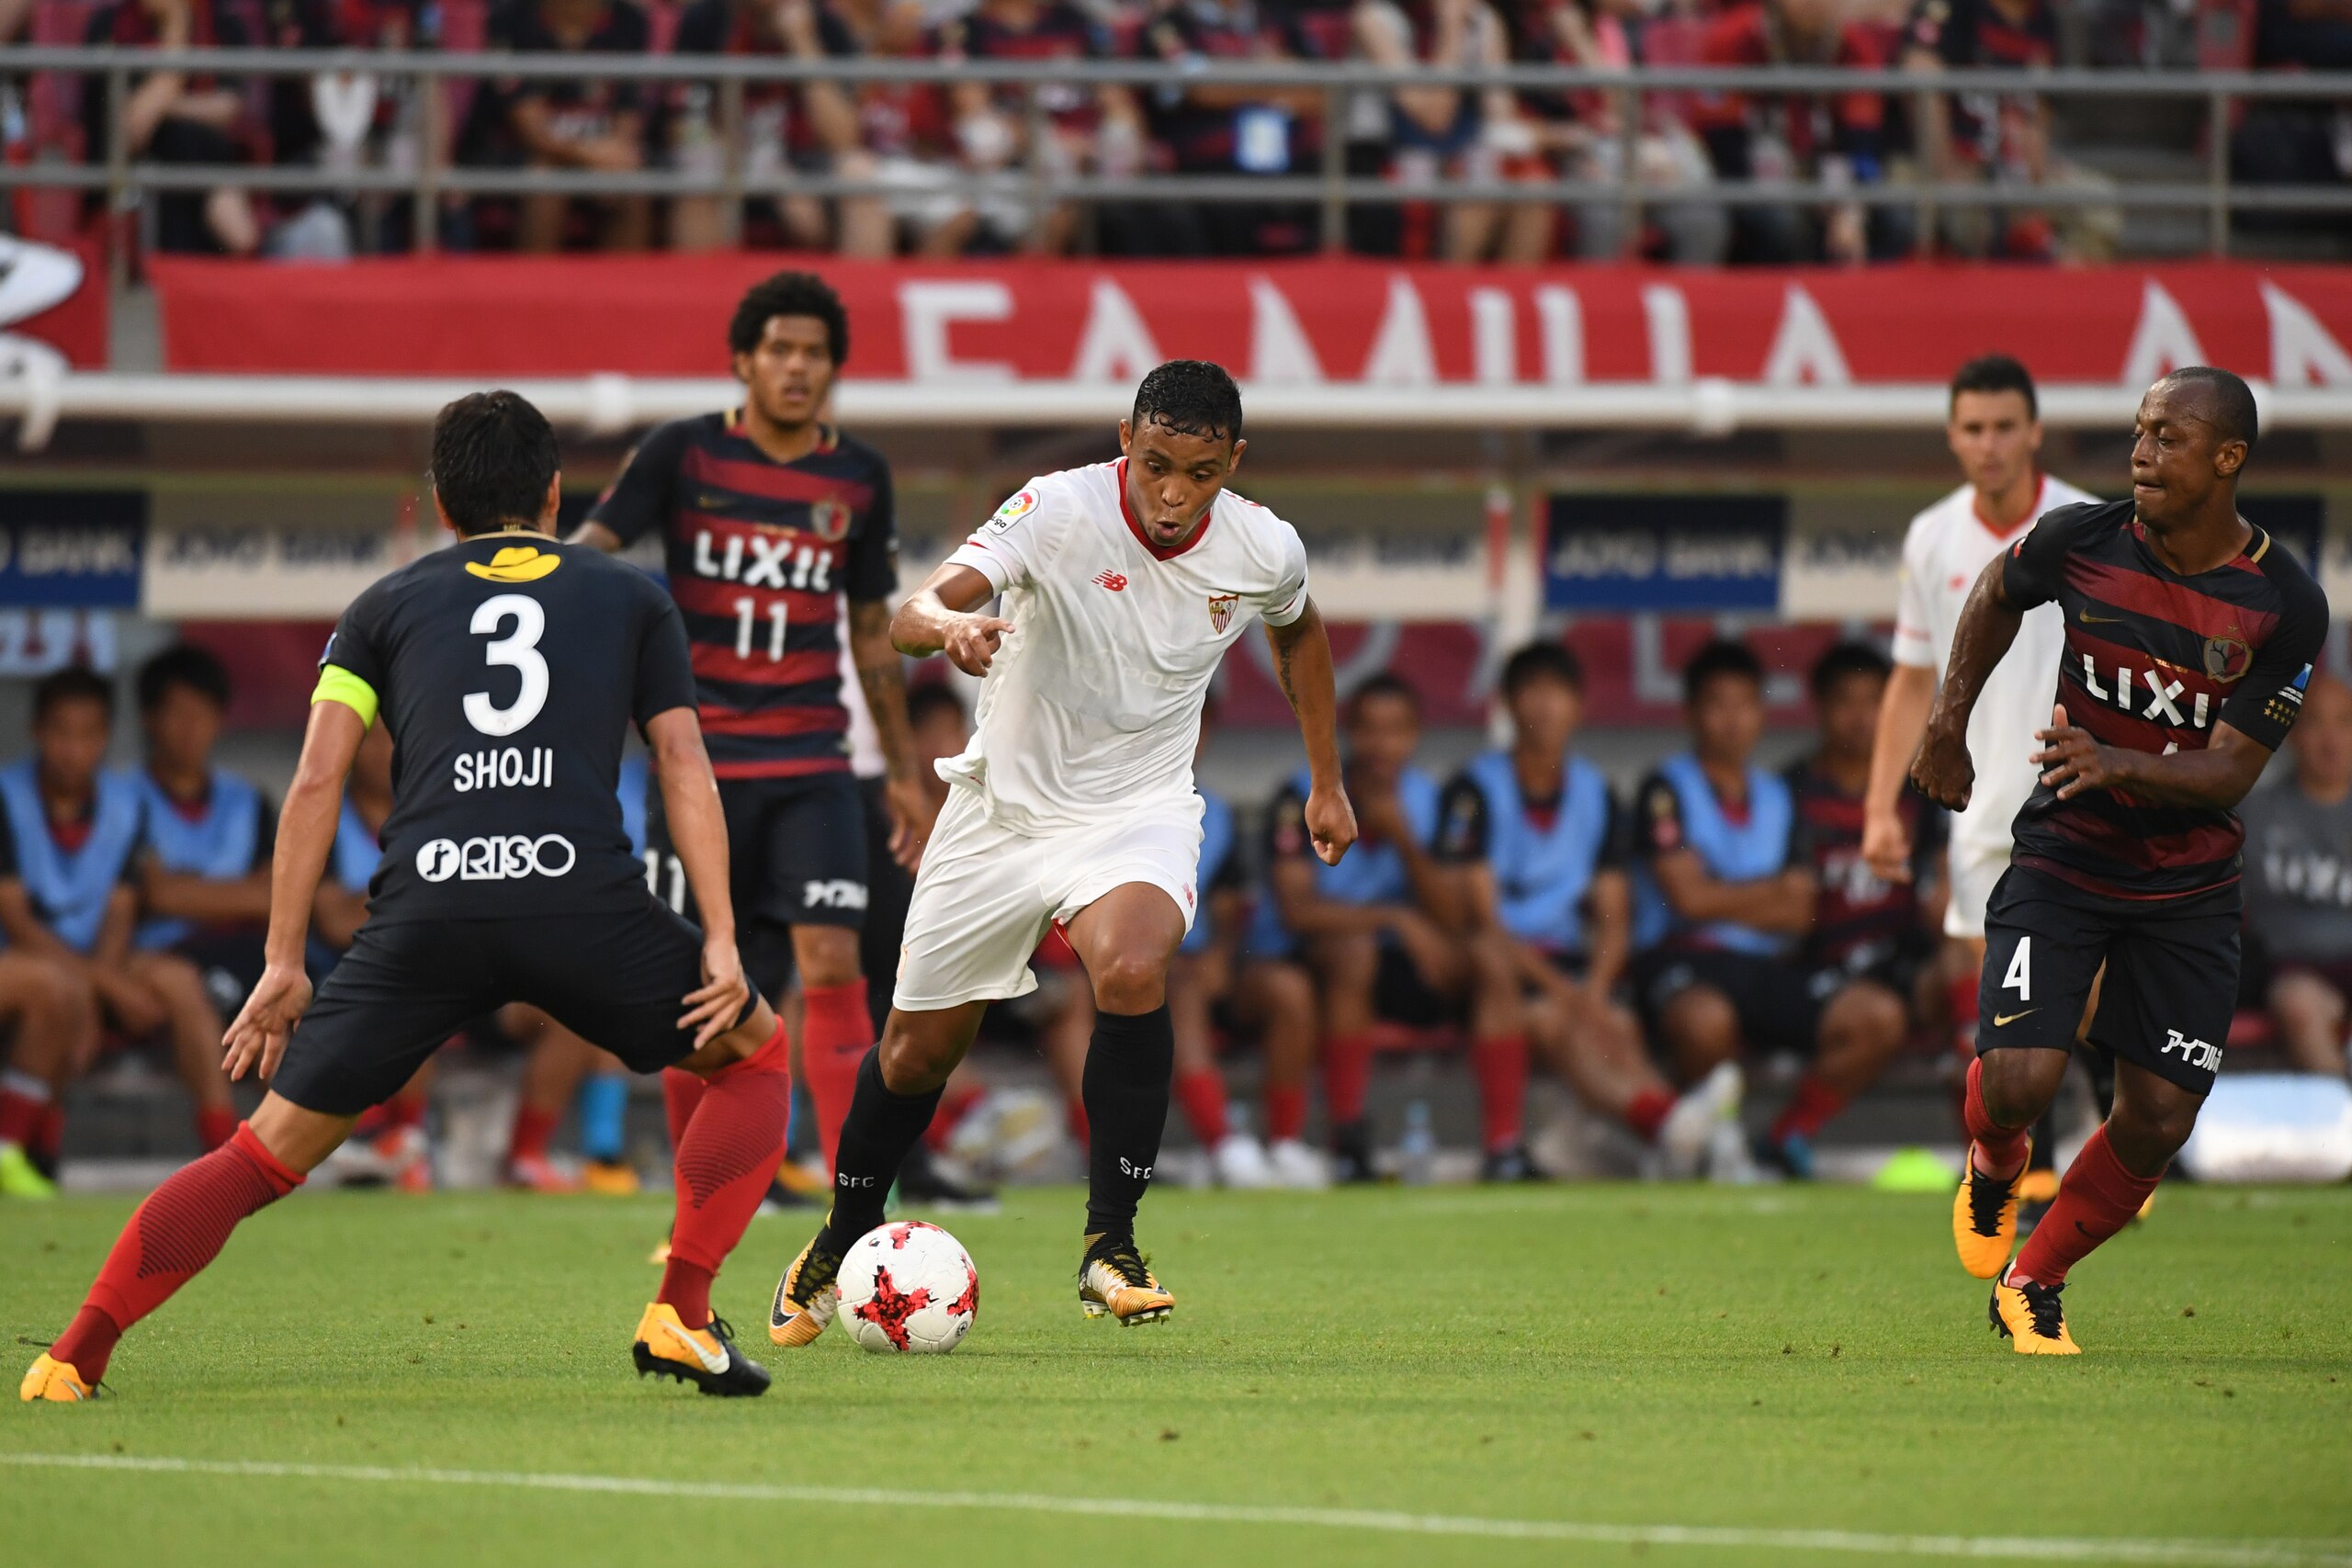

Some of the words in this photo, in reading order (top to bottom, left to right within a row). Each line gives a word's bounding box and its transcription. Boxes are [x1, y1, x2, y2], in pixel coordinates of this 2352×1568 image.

[695, 529, 832, 592] LIXIL
[733, 596, 788, 662] 11
[462, 593, 549, 737] 3
[2083, 653, 2229, 728] LIXI
[453, 747, 553, 792] SHOJI
[460, 833, 576, 880] RISO
[2001, 936, 2030, 1001] 4
[838, 1172, 875, 1189] SFC
[1120, 1156, 1152, 1180] SFC
